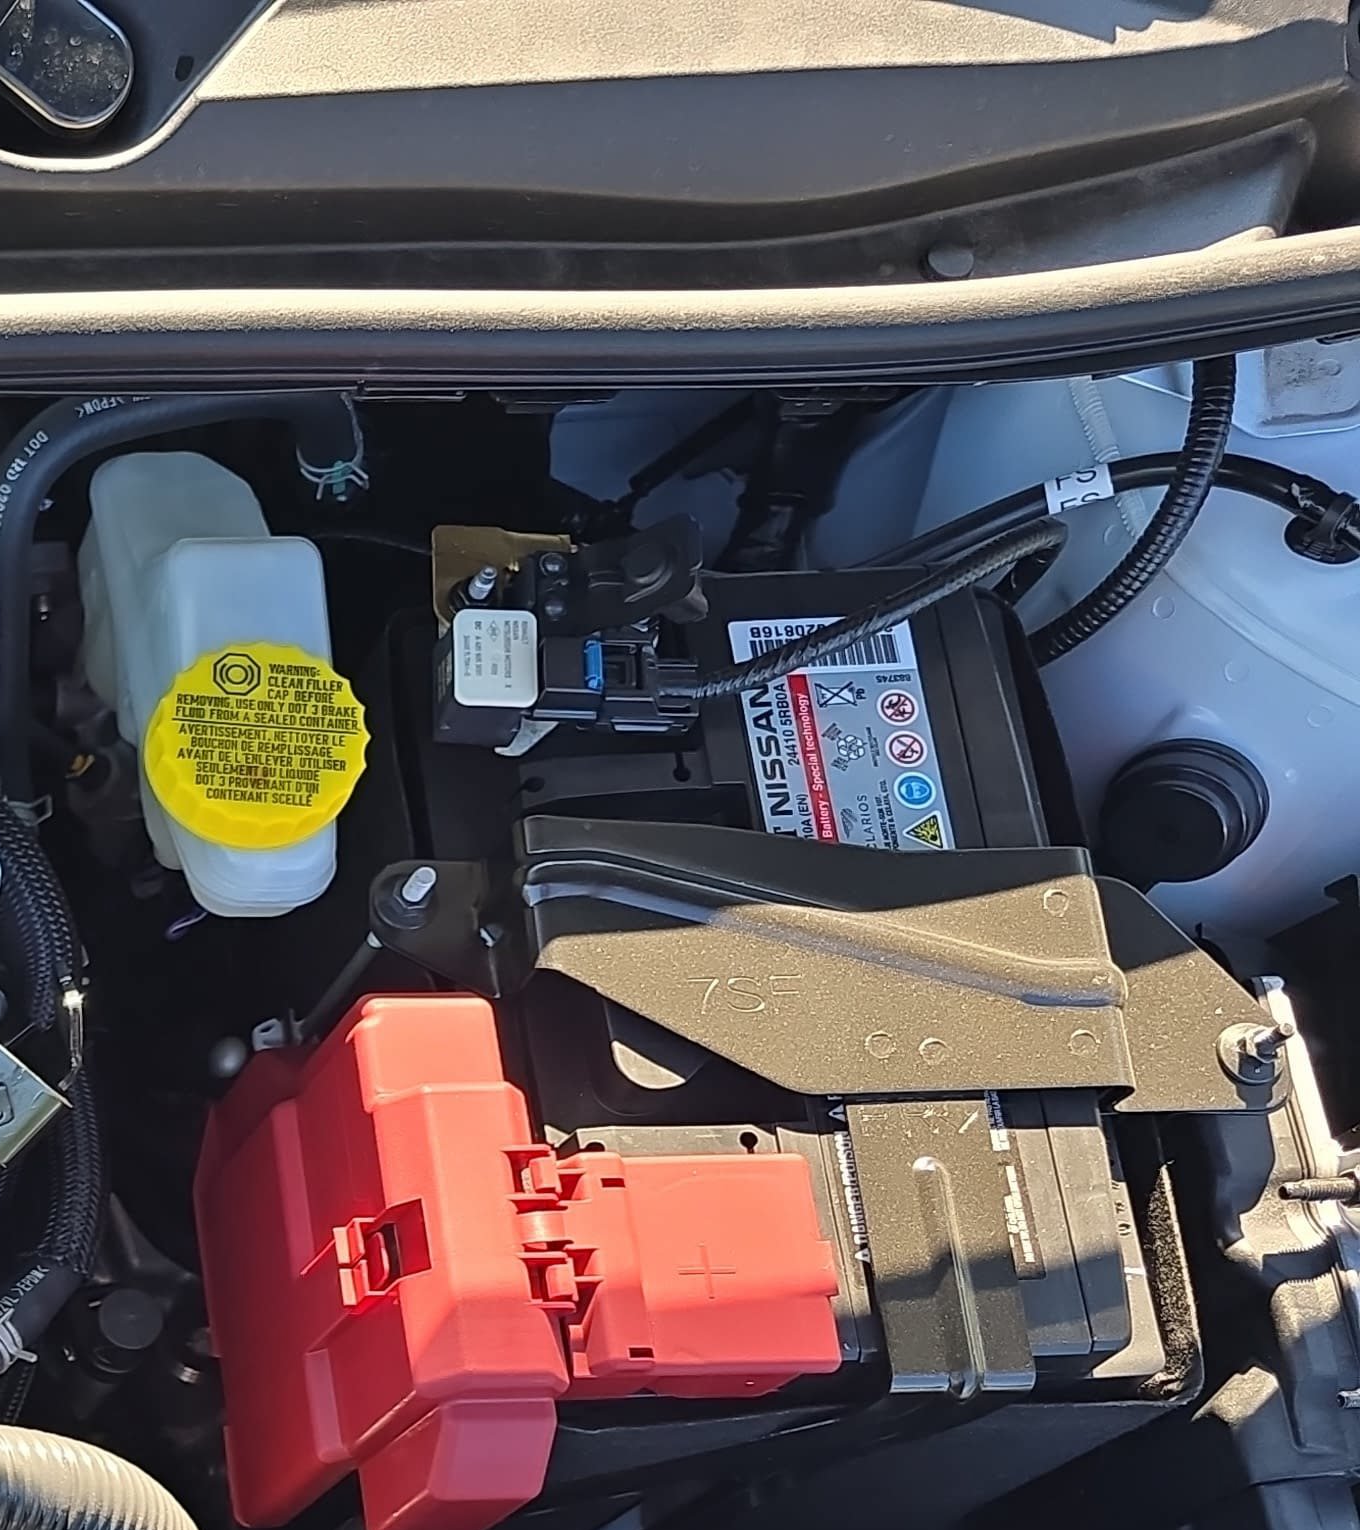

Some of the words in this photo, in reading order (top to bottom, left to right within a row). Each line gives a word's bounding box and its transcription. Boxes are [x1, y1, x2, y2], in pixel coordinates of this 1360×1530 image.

[26, 430, 49, 458] DOT
[268, 664, 320, 677] WARNING:
[268, 676, 303, 690] CLEAN
[306, 679, 344, 692] FILLER
[856, 688, 866, 700] Pb
[267, 689, 289, 701] CAP
[294, 691, 334, 704] BEFORE
[175, 706, 206, 718] FLUID
[209, 709, 239, 721] FROM
[243, 712, 250, 722] A
[254, 713, 297, 726] SEALED
[235, 699, 256, 710] USE
[257, 701, 284, 714] ONLY
[288, 703, 308, 715] DOT
[311, 705, 318, 715] 3
[321, 706, 358, 719] BRAKE
[796, 692, 817, 750] technology
[191, 736, 239, 750] BOUCHON
[241, 739, 254, 751] DE
[257, 742, 333, 759] REMPLISSAGE
[274, 731, 329, 746] NETTOYER
[332, 735, 346, 747] LE
[781, 728, 801, 766] 24410
[177, 748, 215, 761] AVANT
[218, 751, 231, 762] DE
[299, 758, 347, 772] UTILISER
[750, 684, 794, 818] NISSAN
[196, 762, 259, 777] SEULEMENT
[260, 766, 276, 778] DU
[279, 768, 321, 782] LIQUIDE
[807, 752, 825, 791] Special
[195, 774, 215, 786] DOT
[219, 776, 226, 786] 3
[228, 777, 293, 793] PROVENANT
[295, 782, 320, 794] D'UN
[206, 788, 269, 804] CONTENANT
[271, 793, 313, 807] SCELLÉ
[815, 795, 834, 839] Battery
